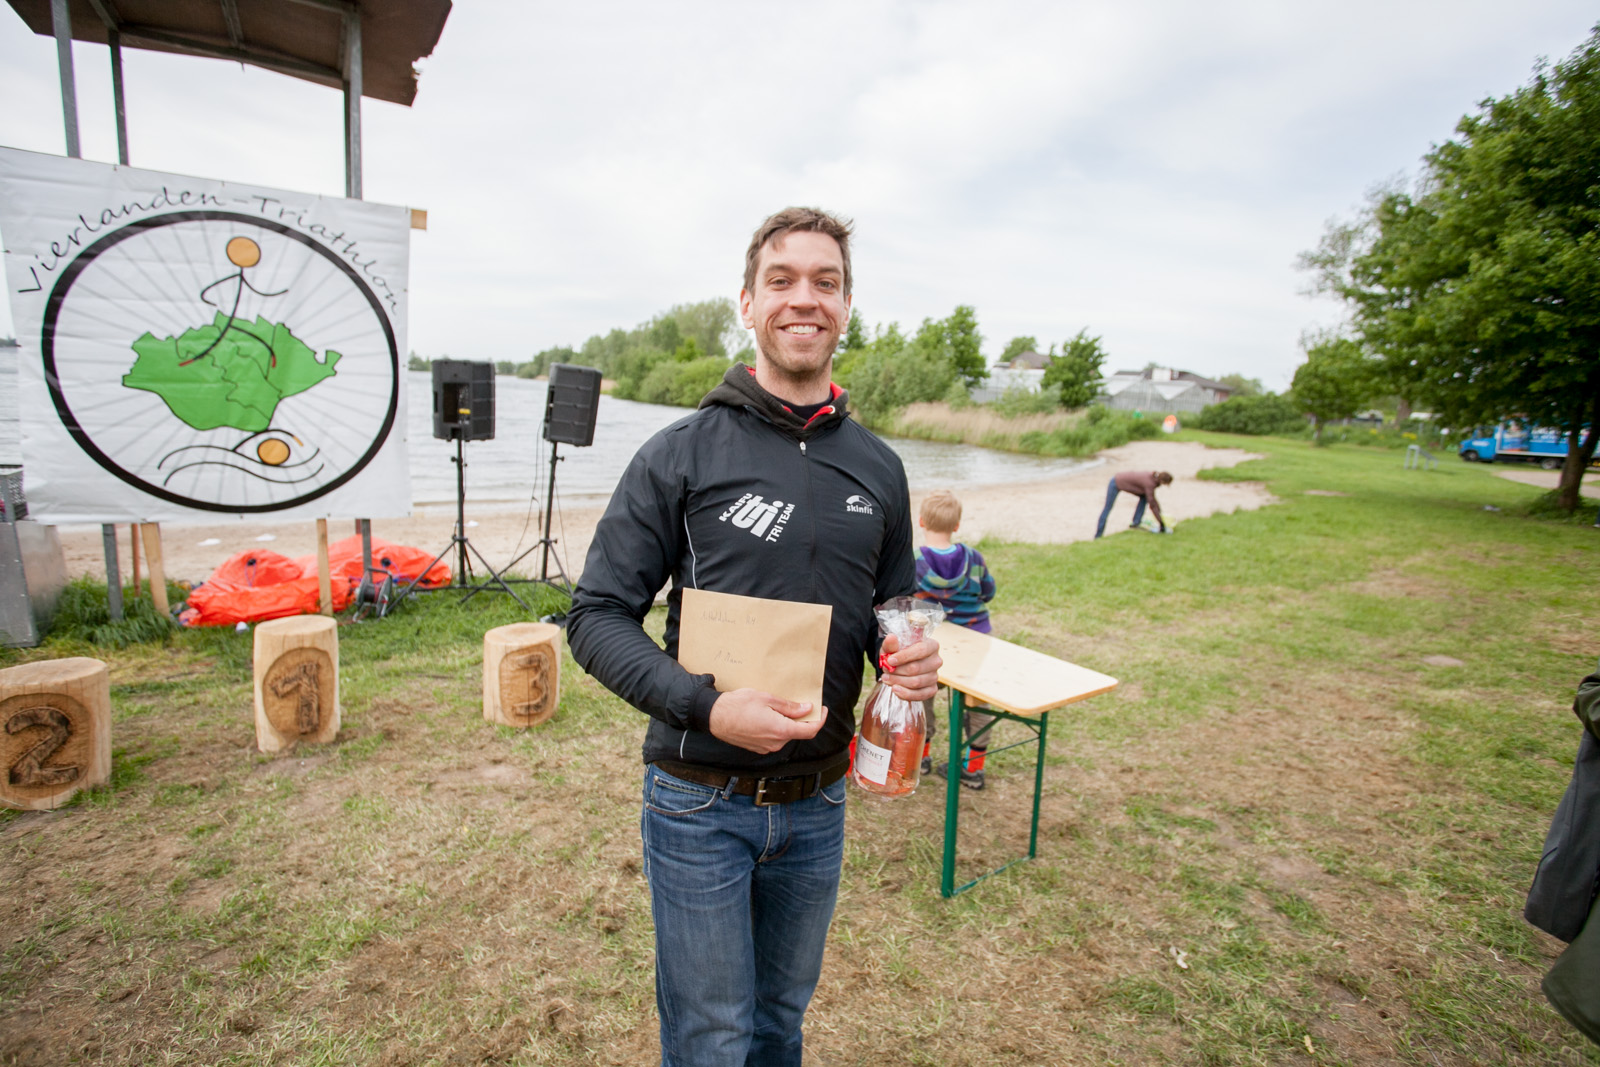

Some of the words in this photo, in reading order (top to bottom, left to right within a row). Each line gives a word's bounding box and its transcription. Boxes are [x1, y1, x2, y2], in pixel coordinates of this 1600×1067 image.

[719, 492, 753, 522] KAIFU
[765, 524, 784, 543] TRI
[777, 503, 796, 527] TEAM
[846, 505, 873, 515] skinfit
[269, 661, 323, 734] 1
[515, 654, 550, 716] 3
[4, 706, 80, 785] 2
